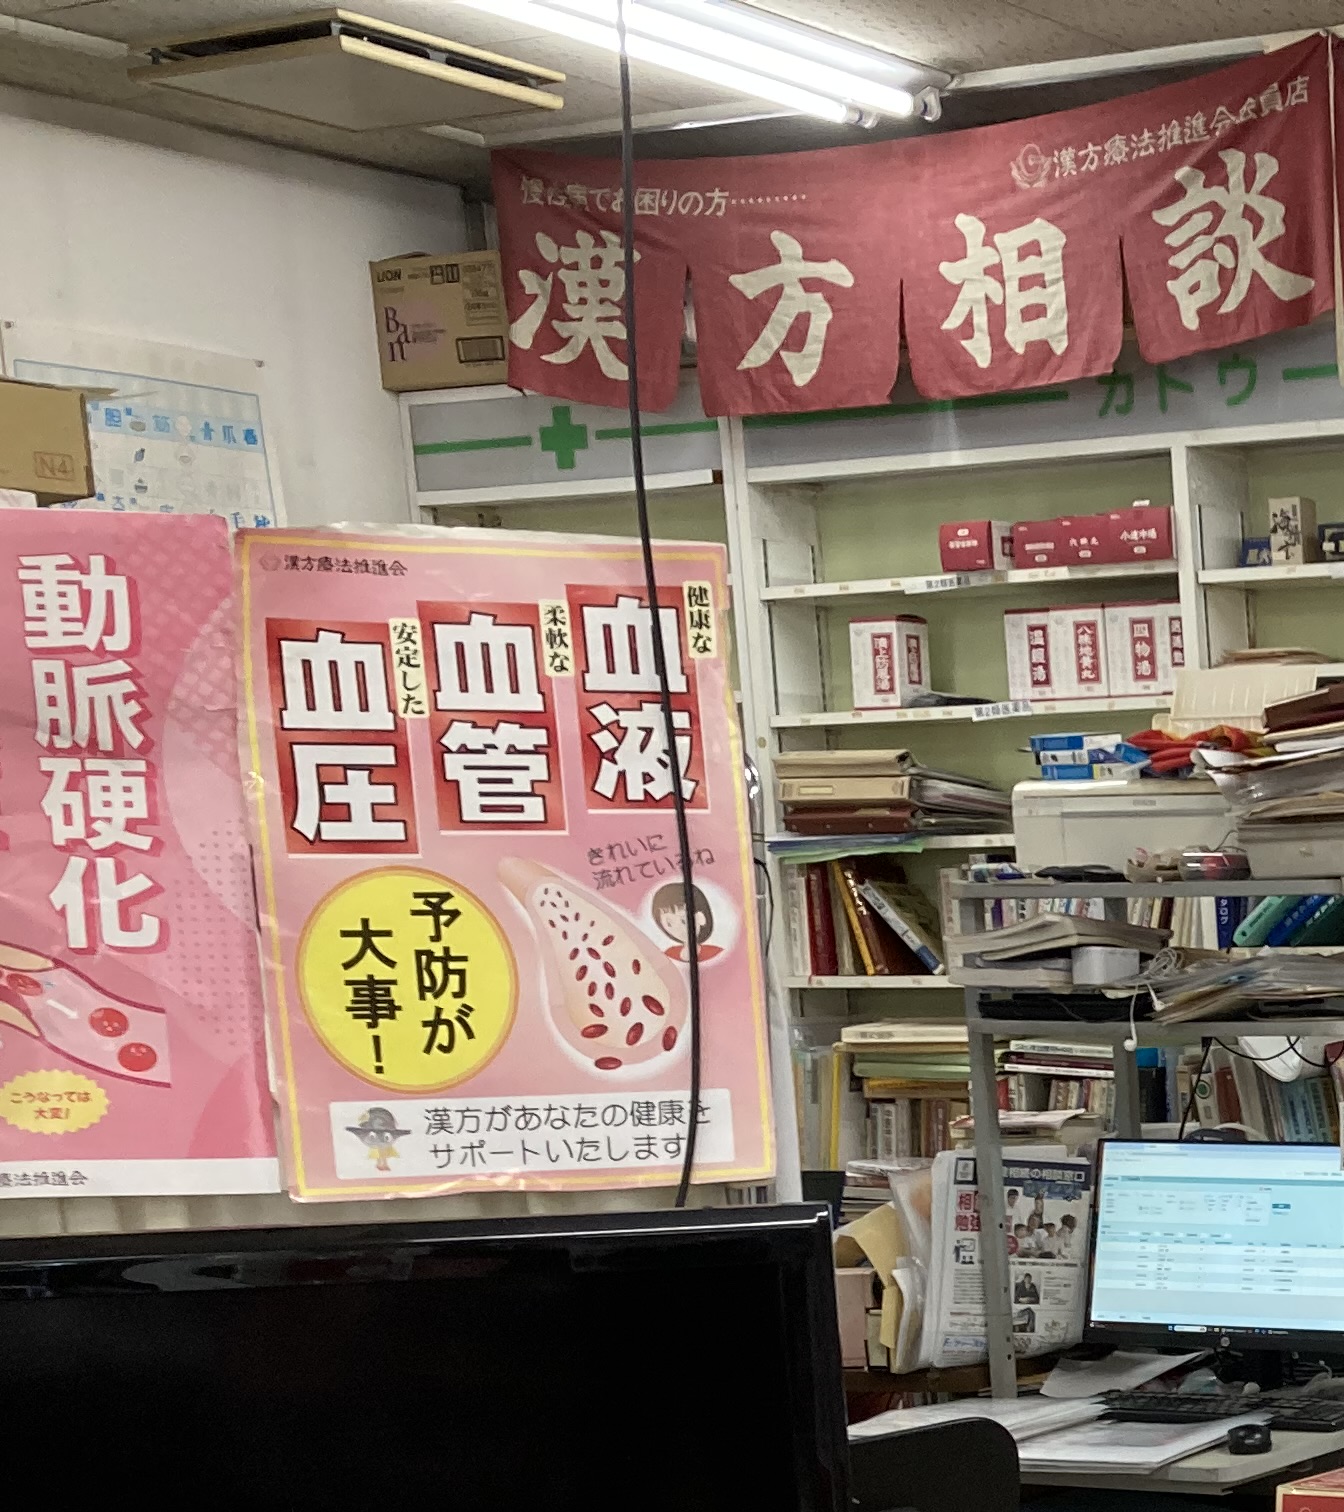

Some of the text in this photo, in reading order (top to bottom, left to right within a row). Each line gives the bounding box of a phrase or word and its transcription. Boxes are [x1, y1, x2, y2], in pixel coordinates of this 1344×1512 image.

[509, 150, 1315, 387] 漢方相談
[1098, 357, 1258, 416] カトウ
[391, 621, 425, 715] 安定した
[543, 602, 571, 675] 柔軟な
[581, 595, 697, 802] 血液
[685, 583, 713, 655] 健康な
[17, 553, 160, 950] 動脈硬化
[279, 628, 408, 845] 血圧
[432, 611, 552, 826] 血管
[409, 889, 477, 1056] 予防が
[430, 1131, 688, 1168] サポートいたします
